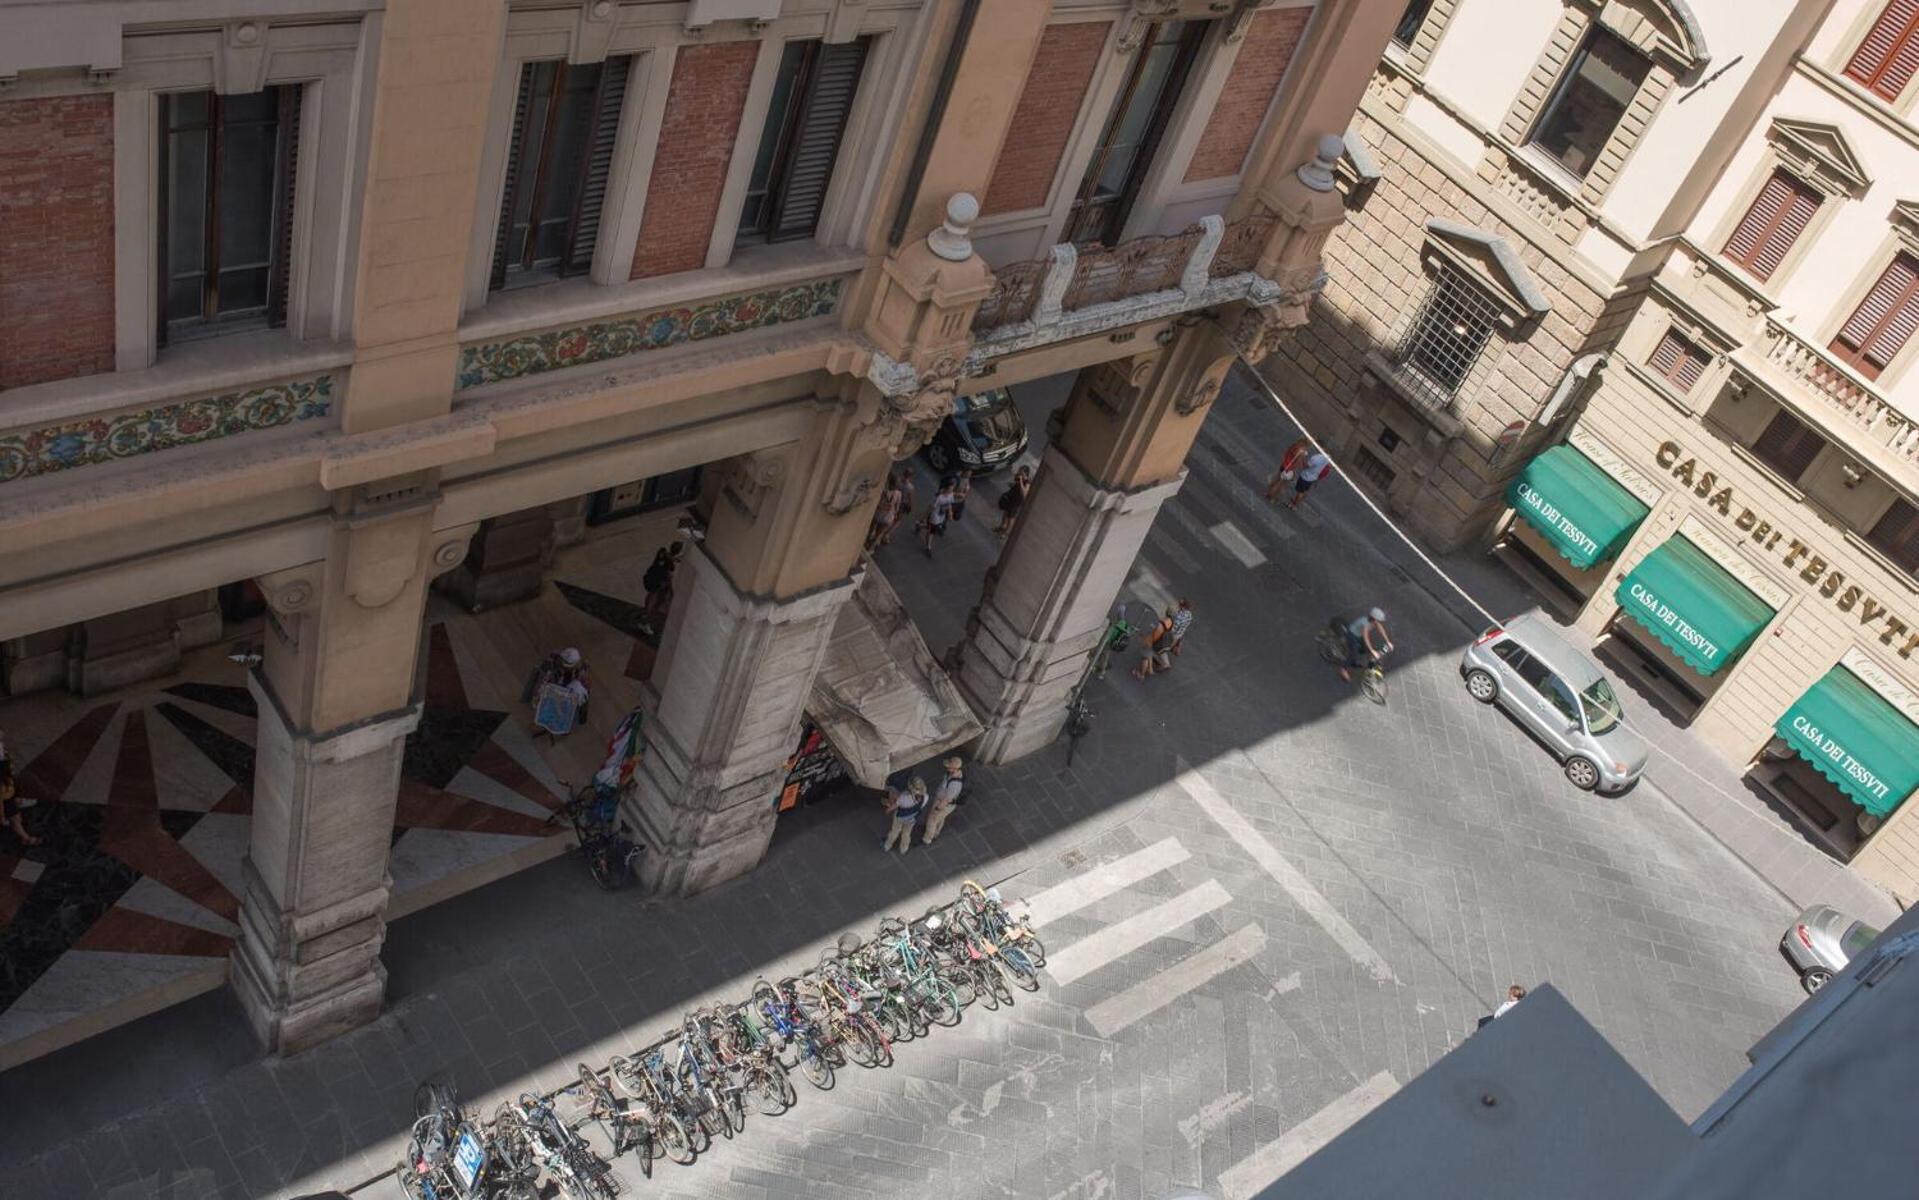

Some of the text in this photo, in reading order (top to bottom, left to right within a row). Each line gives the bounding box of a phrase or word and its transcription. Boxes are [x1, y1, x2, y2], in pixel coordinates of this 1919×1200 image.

[1517, 483, 1598, 556] CASA DEI TESSVTI
[1655, 440, 1919, 660] CASA DEI TESSVTI
[1630, 583, 1719, 660] CASA DEI TESSVTI
[1793, 716, 1890, 800] CASA DEI TESSVTI
